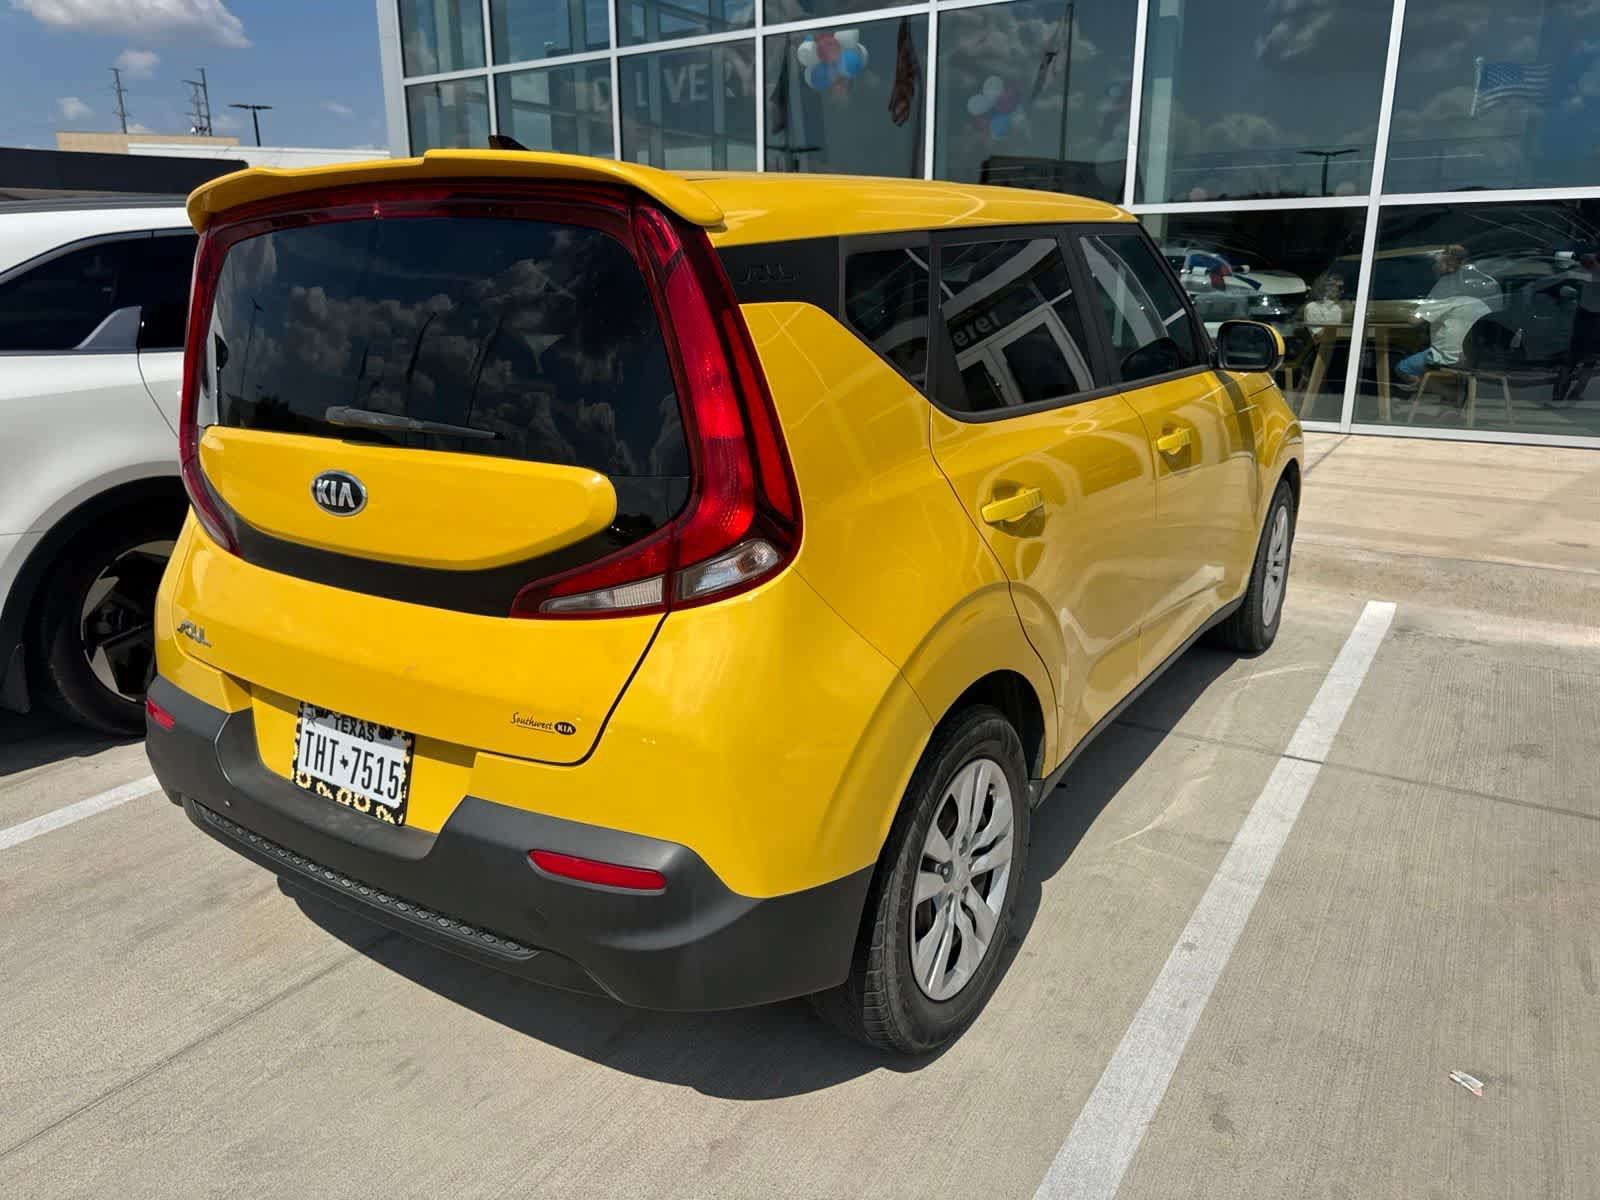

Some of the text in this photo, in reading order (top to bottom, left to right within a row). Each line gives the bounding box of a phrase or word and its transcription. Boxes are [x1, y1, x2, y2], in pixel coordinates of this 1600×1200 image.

[592, 57, 757, 111] DLVEY
[315, 478, 356, 508] KIA
[334, 716, 376, 742] TEXAS
[510, 712, 575, 734] Southwest KIA
